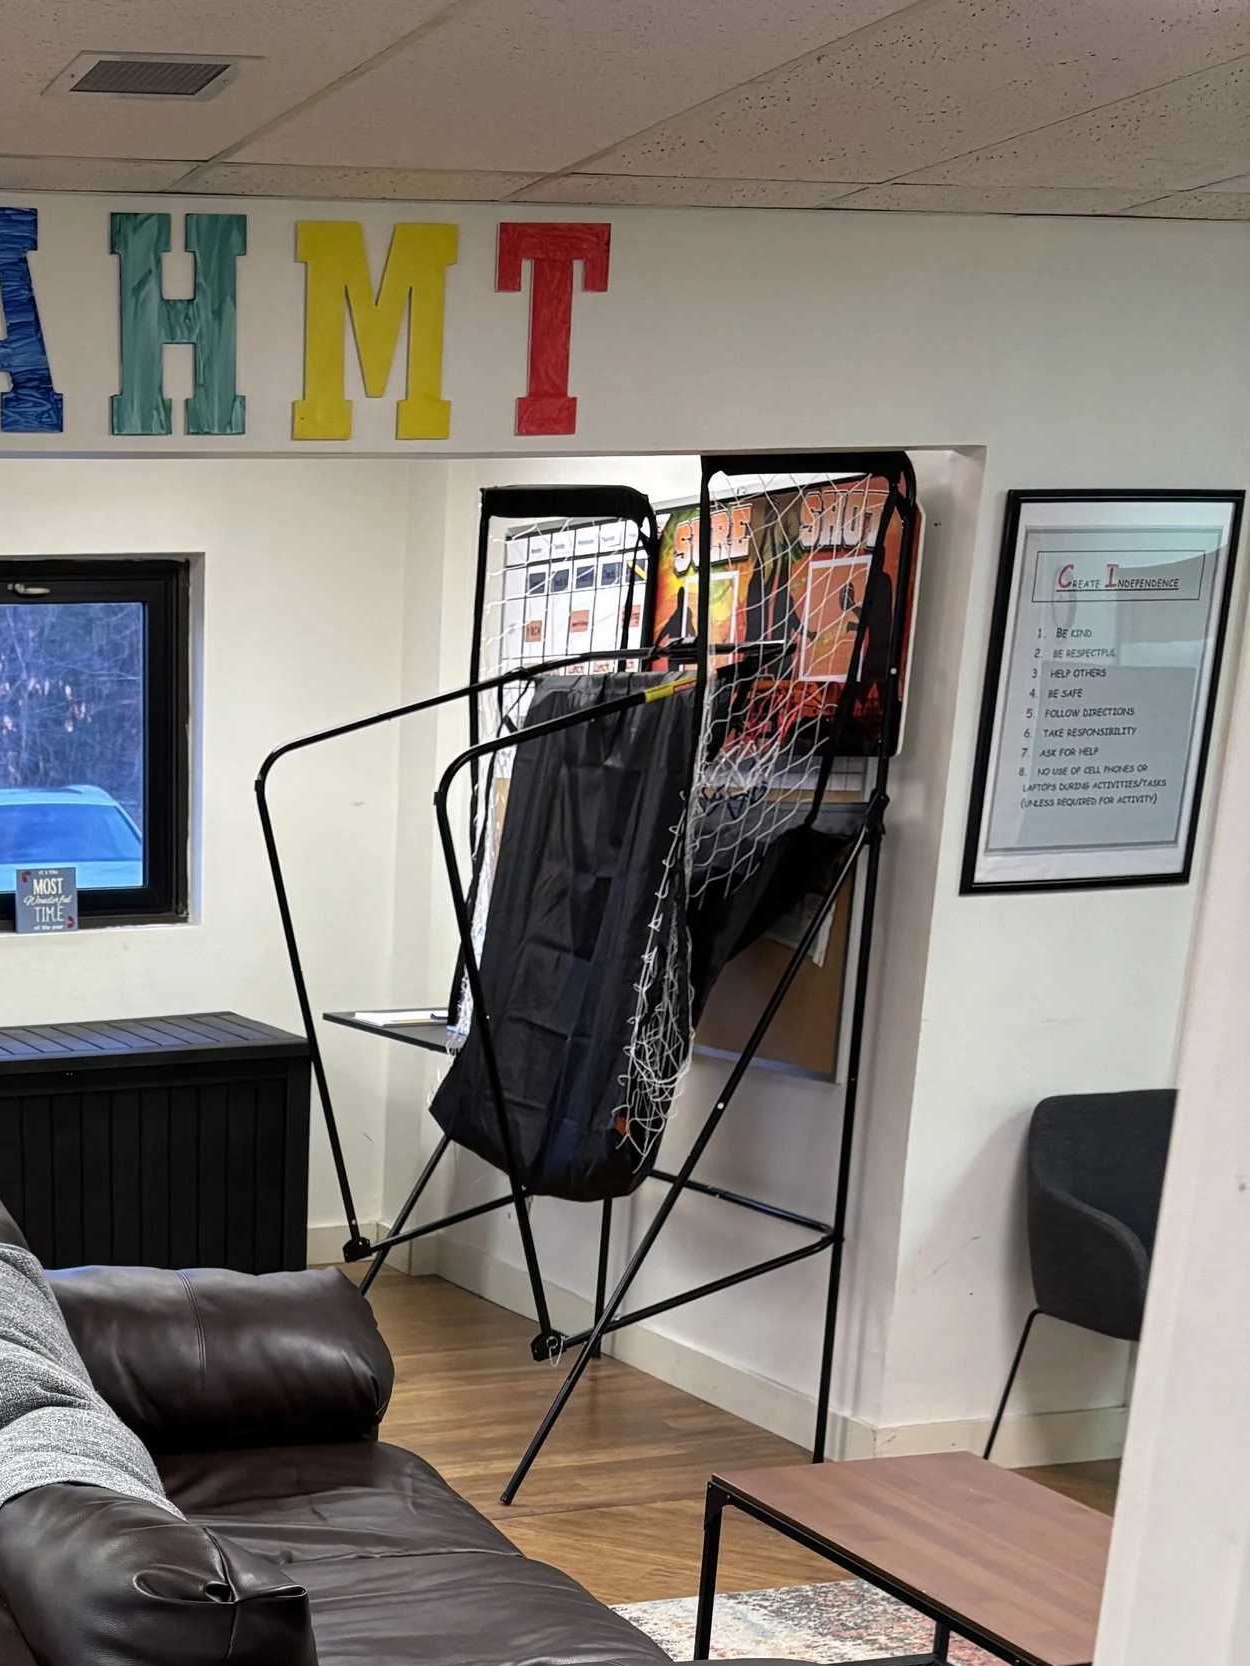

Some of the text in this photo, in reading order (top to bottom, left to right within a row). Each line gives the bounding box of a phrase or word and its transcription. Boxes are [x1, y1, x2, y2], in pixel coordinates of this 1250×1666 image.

[1058, 564, 1179, 588] CREATE INDEPENDENCE
[1056, 628, 1068, 638] BE
[1071, 629, 1092, 638] KIND
[1053, 649, 1063, 658] BE
[1066, 648, 1116, 658] RESPECTFUL
[1050, 669, 1071, 678] HELP
[1073, 668, 1106, 677] OTHERS
[1047, 689, 1059, 698] BE
[1061, 688, 1083, 698] SAFE
[1045, 709, 1080, 718] FOLLOW
[1083, 707, 1135, 716] DIRECTIONS
[1043, 728, 1064, 738] TAKE
[1067, 727, 1137, 737] RESPONSIBILITY
[1040, 749, 1056, 757] ASK
[1059, 748, 1076, 757] FOR
[1079, 747, 1099, 756] HELP
[1037, 767, 1050, 776] NO
[1052, 767, 1068, 775] USE
[1070, 767, 1080, 775] OF
[1084, 766, 1100, 775] CELL
[1104, 765, 1135, 774] PHONES
[1137, 764, 1148, 772] OR
[1022, 778, 1166, 792] LAPTOPS DURING ACTIVITIES/TASKS
[1020, 793, 1158, 809] (UNLESS REQUIRED FOR ACTIVITY)
[33, 877, 64, 895] MOST
[34, 905, 64, 923] TIME
